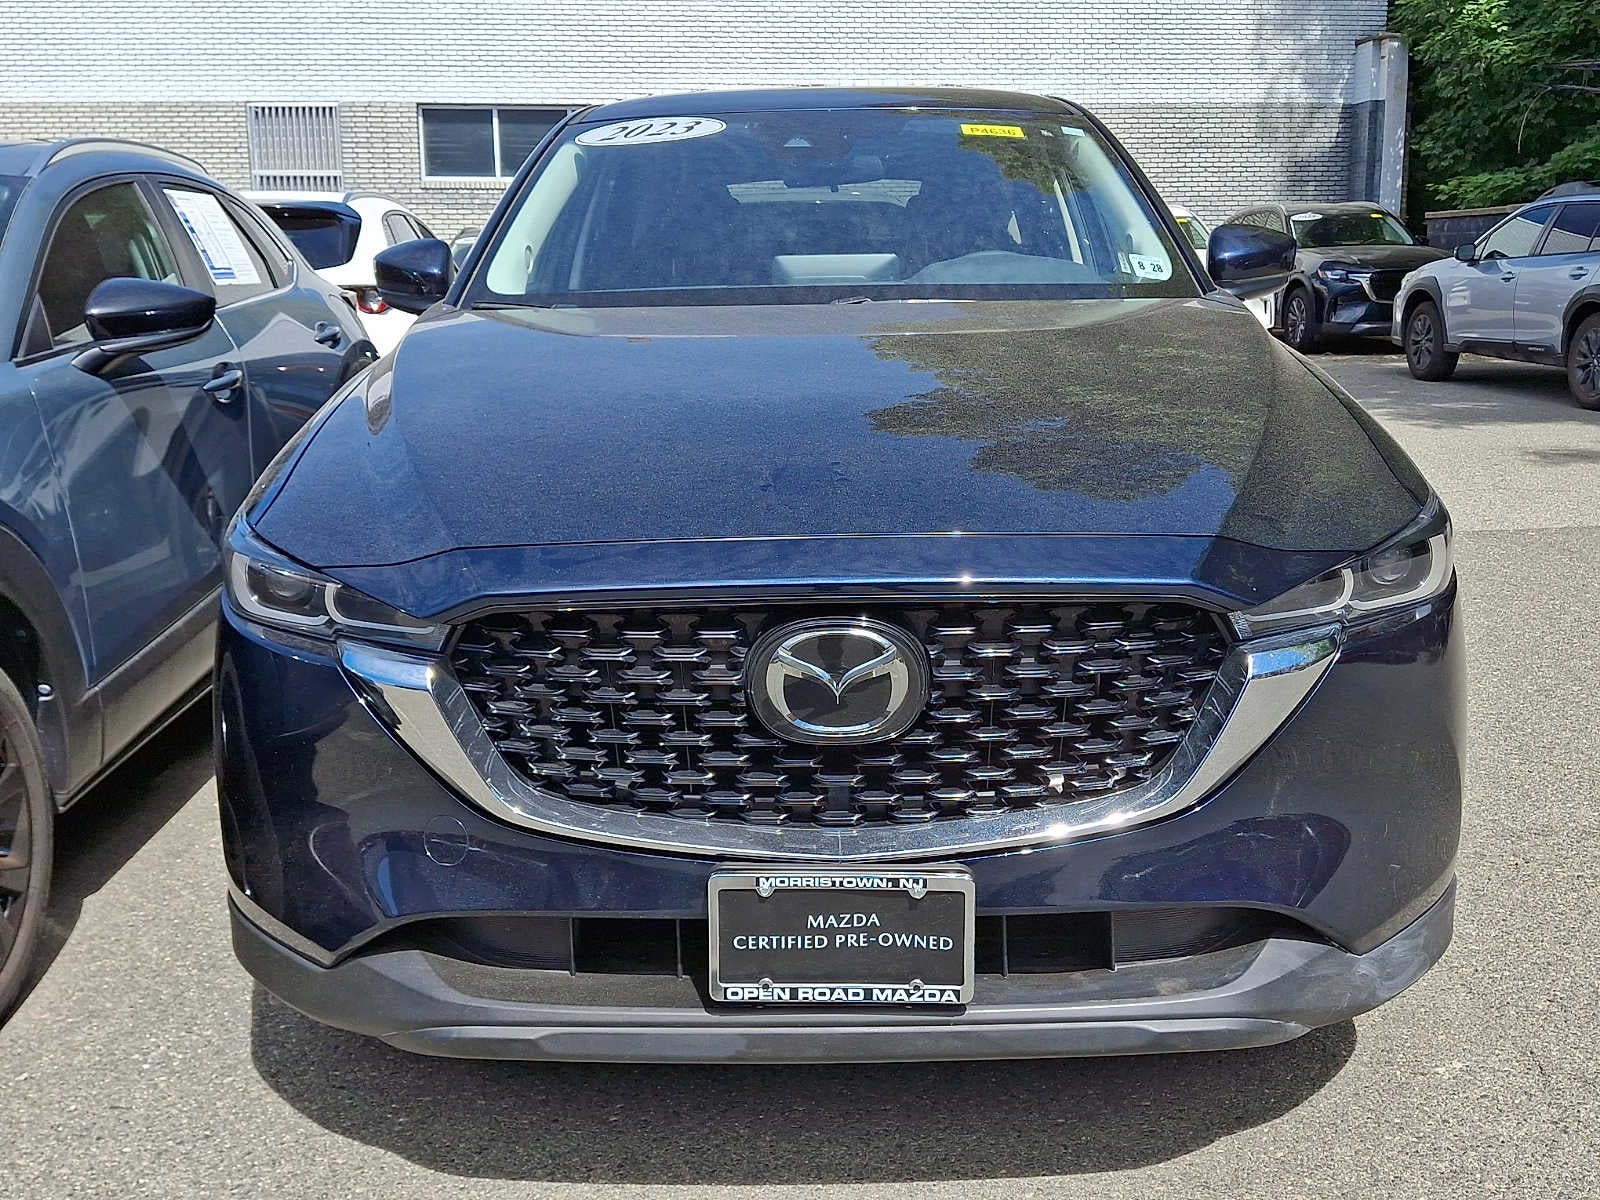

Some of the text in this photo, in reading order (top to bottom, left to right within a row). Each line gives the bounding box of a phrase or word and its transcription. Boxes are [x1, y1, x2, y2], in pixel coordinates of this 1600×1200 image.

[598, 121, 702, 142] 2023
[1137, 261, 1145, 270] 8
[1150, 262, 1163, 272] 28
[899, 878, 924, 890] NJ
[807, 913, 880, 929] MAZDA
[733, 932, 954, 950] CERTIFIED PRE-OWNED
[726, 987, 959, 1002] OPEN ROAD MAZDA
